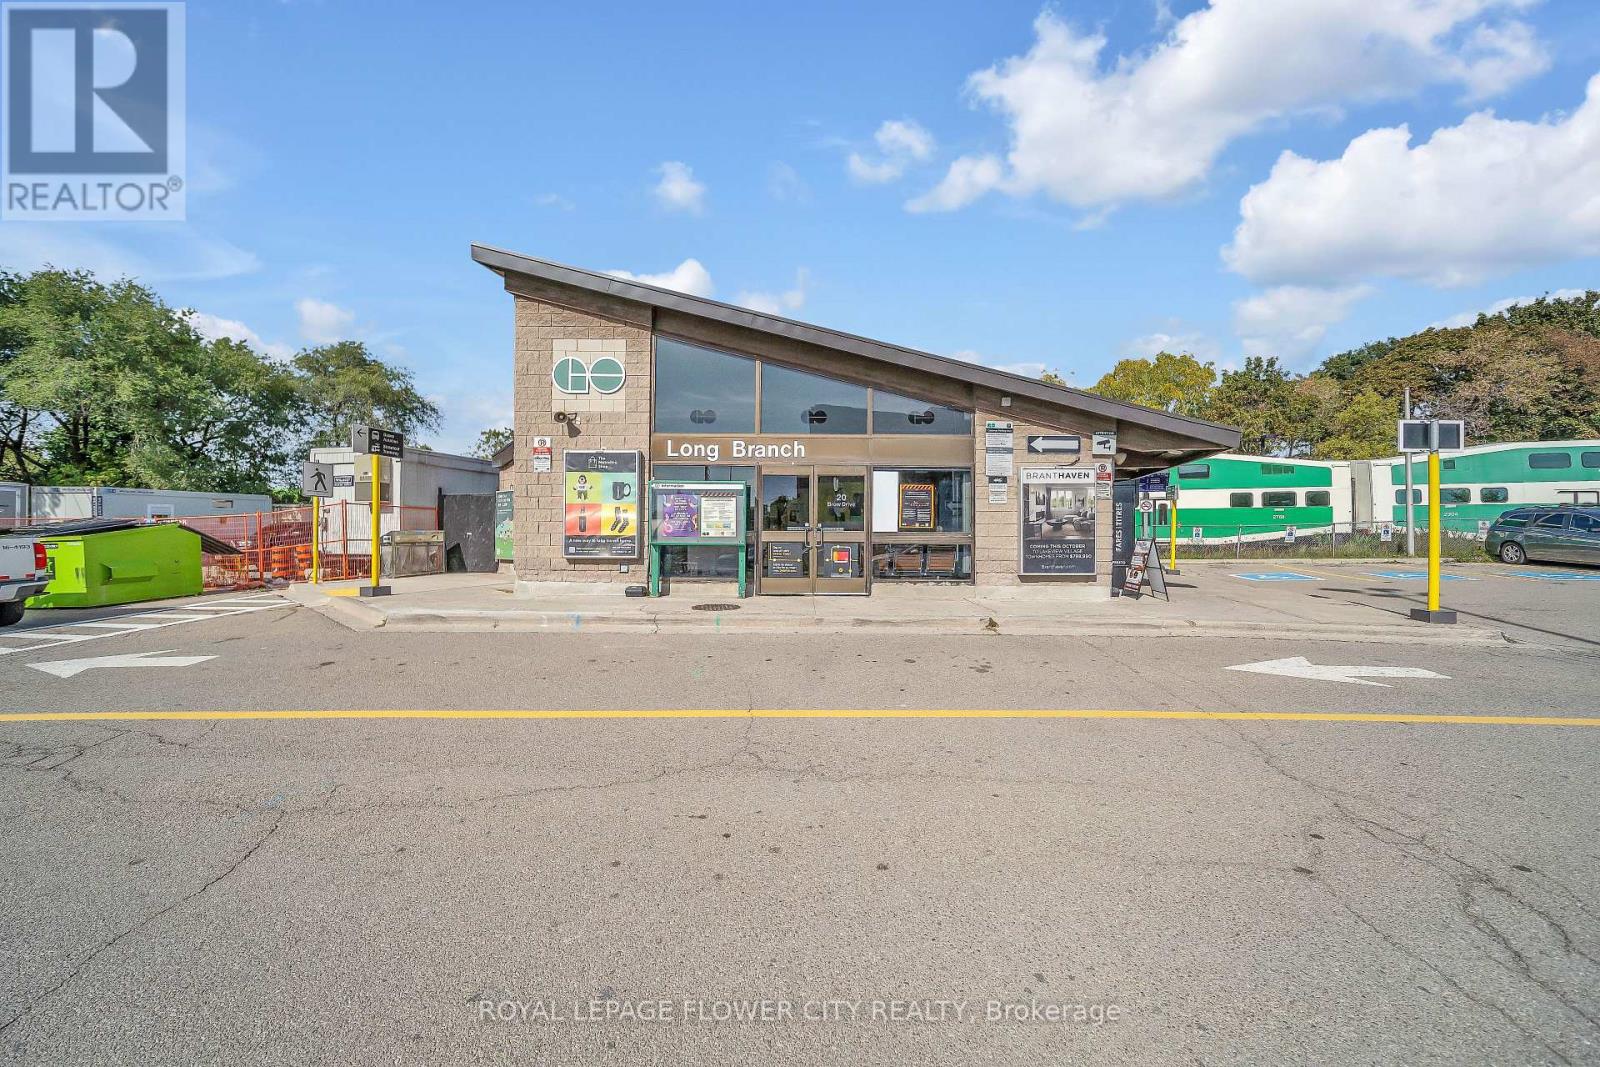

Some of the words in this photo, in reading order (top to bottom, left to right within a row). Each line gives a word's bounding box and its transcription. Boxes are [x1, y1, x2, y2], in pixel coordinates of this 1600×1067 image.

[667, 440, 719, 461] Long
[733, 441, 805, 458] Branch
[1026, 471, 1090, 480] BRANTHAVEN
